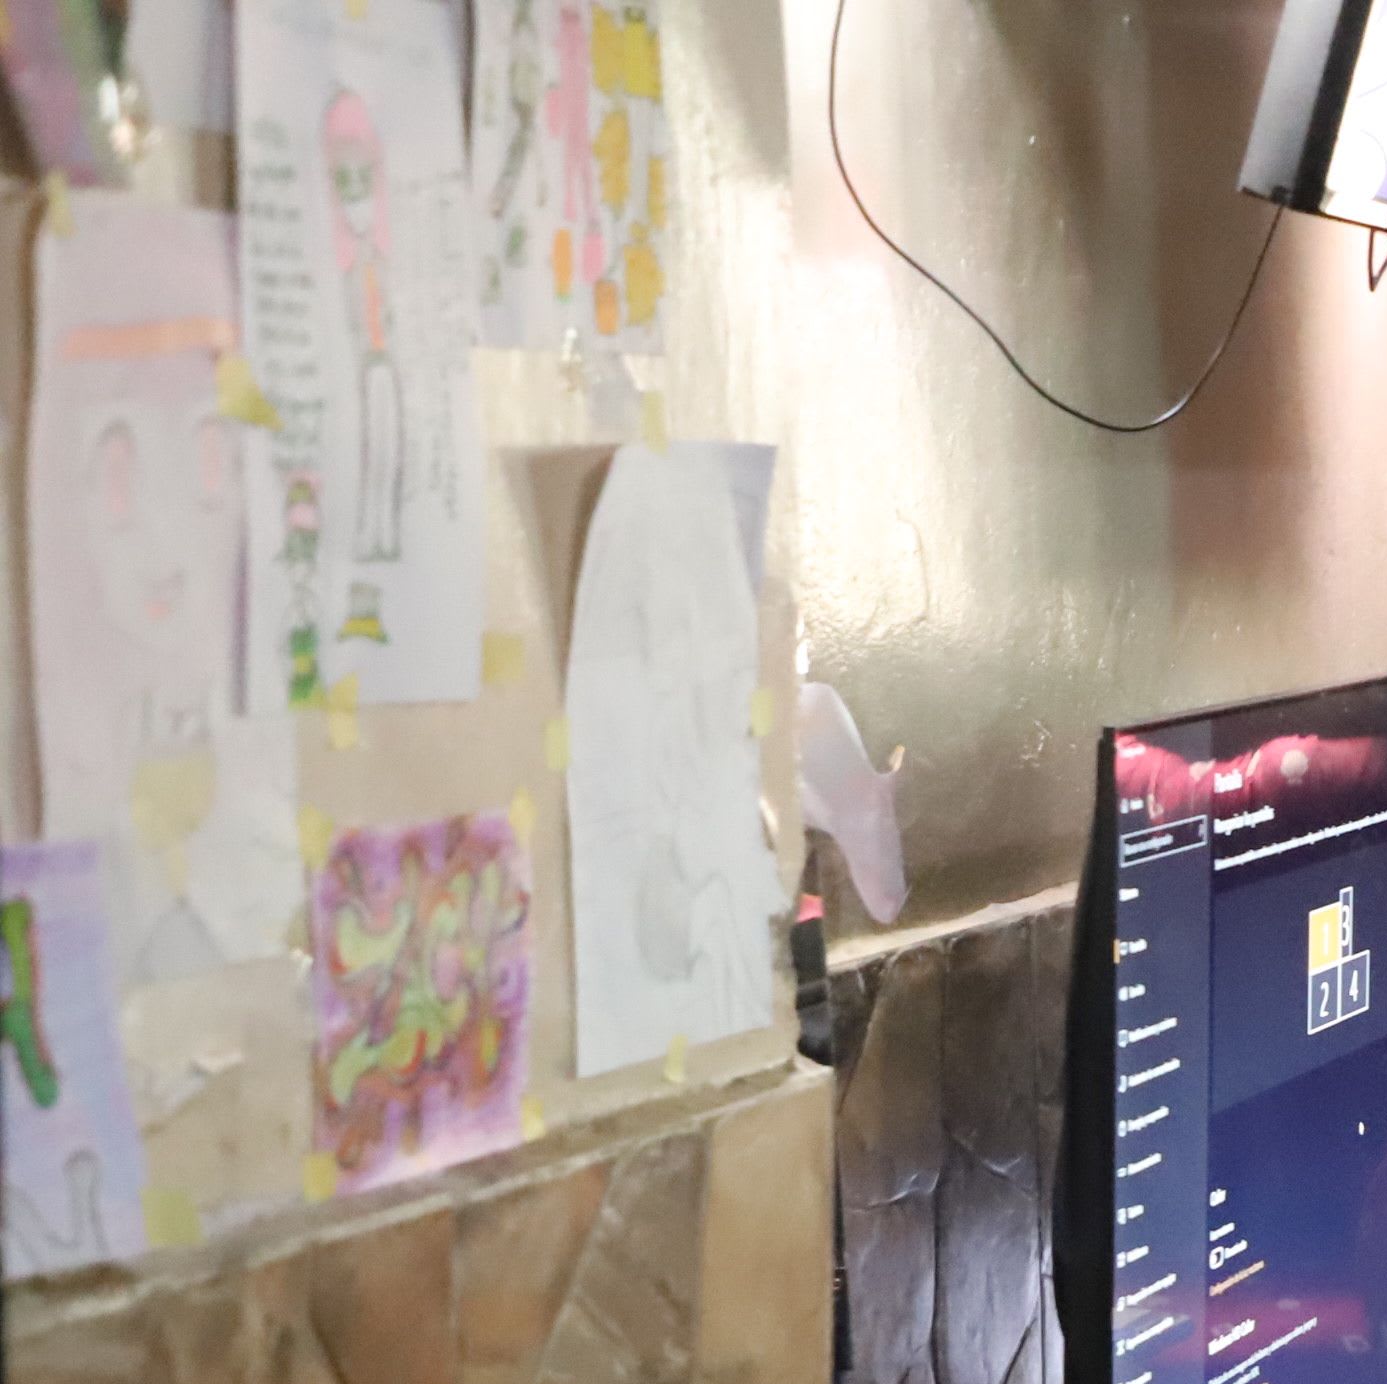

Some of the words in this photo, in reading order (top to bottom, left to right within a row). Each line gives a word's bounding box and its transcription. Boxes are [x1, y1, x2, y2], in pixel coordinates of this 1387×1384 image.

[1322, 921, 1330, 957] 1
[1340, 904, 1350, 947] 3
[1319, 981, 1330, 1018] 2
[1348, 969, 1360, 1002] 4
